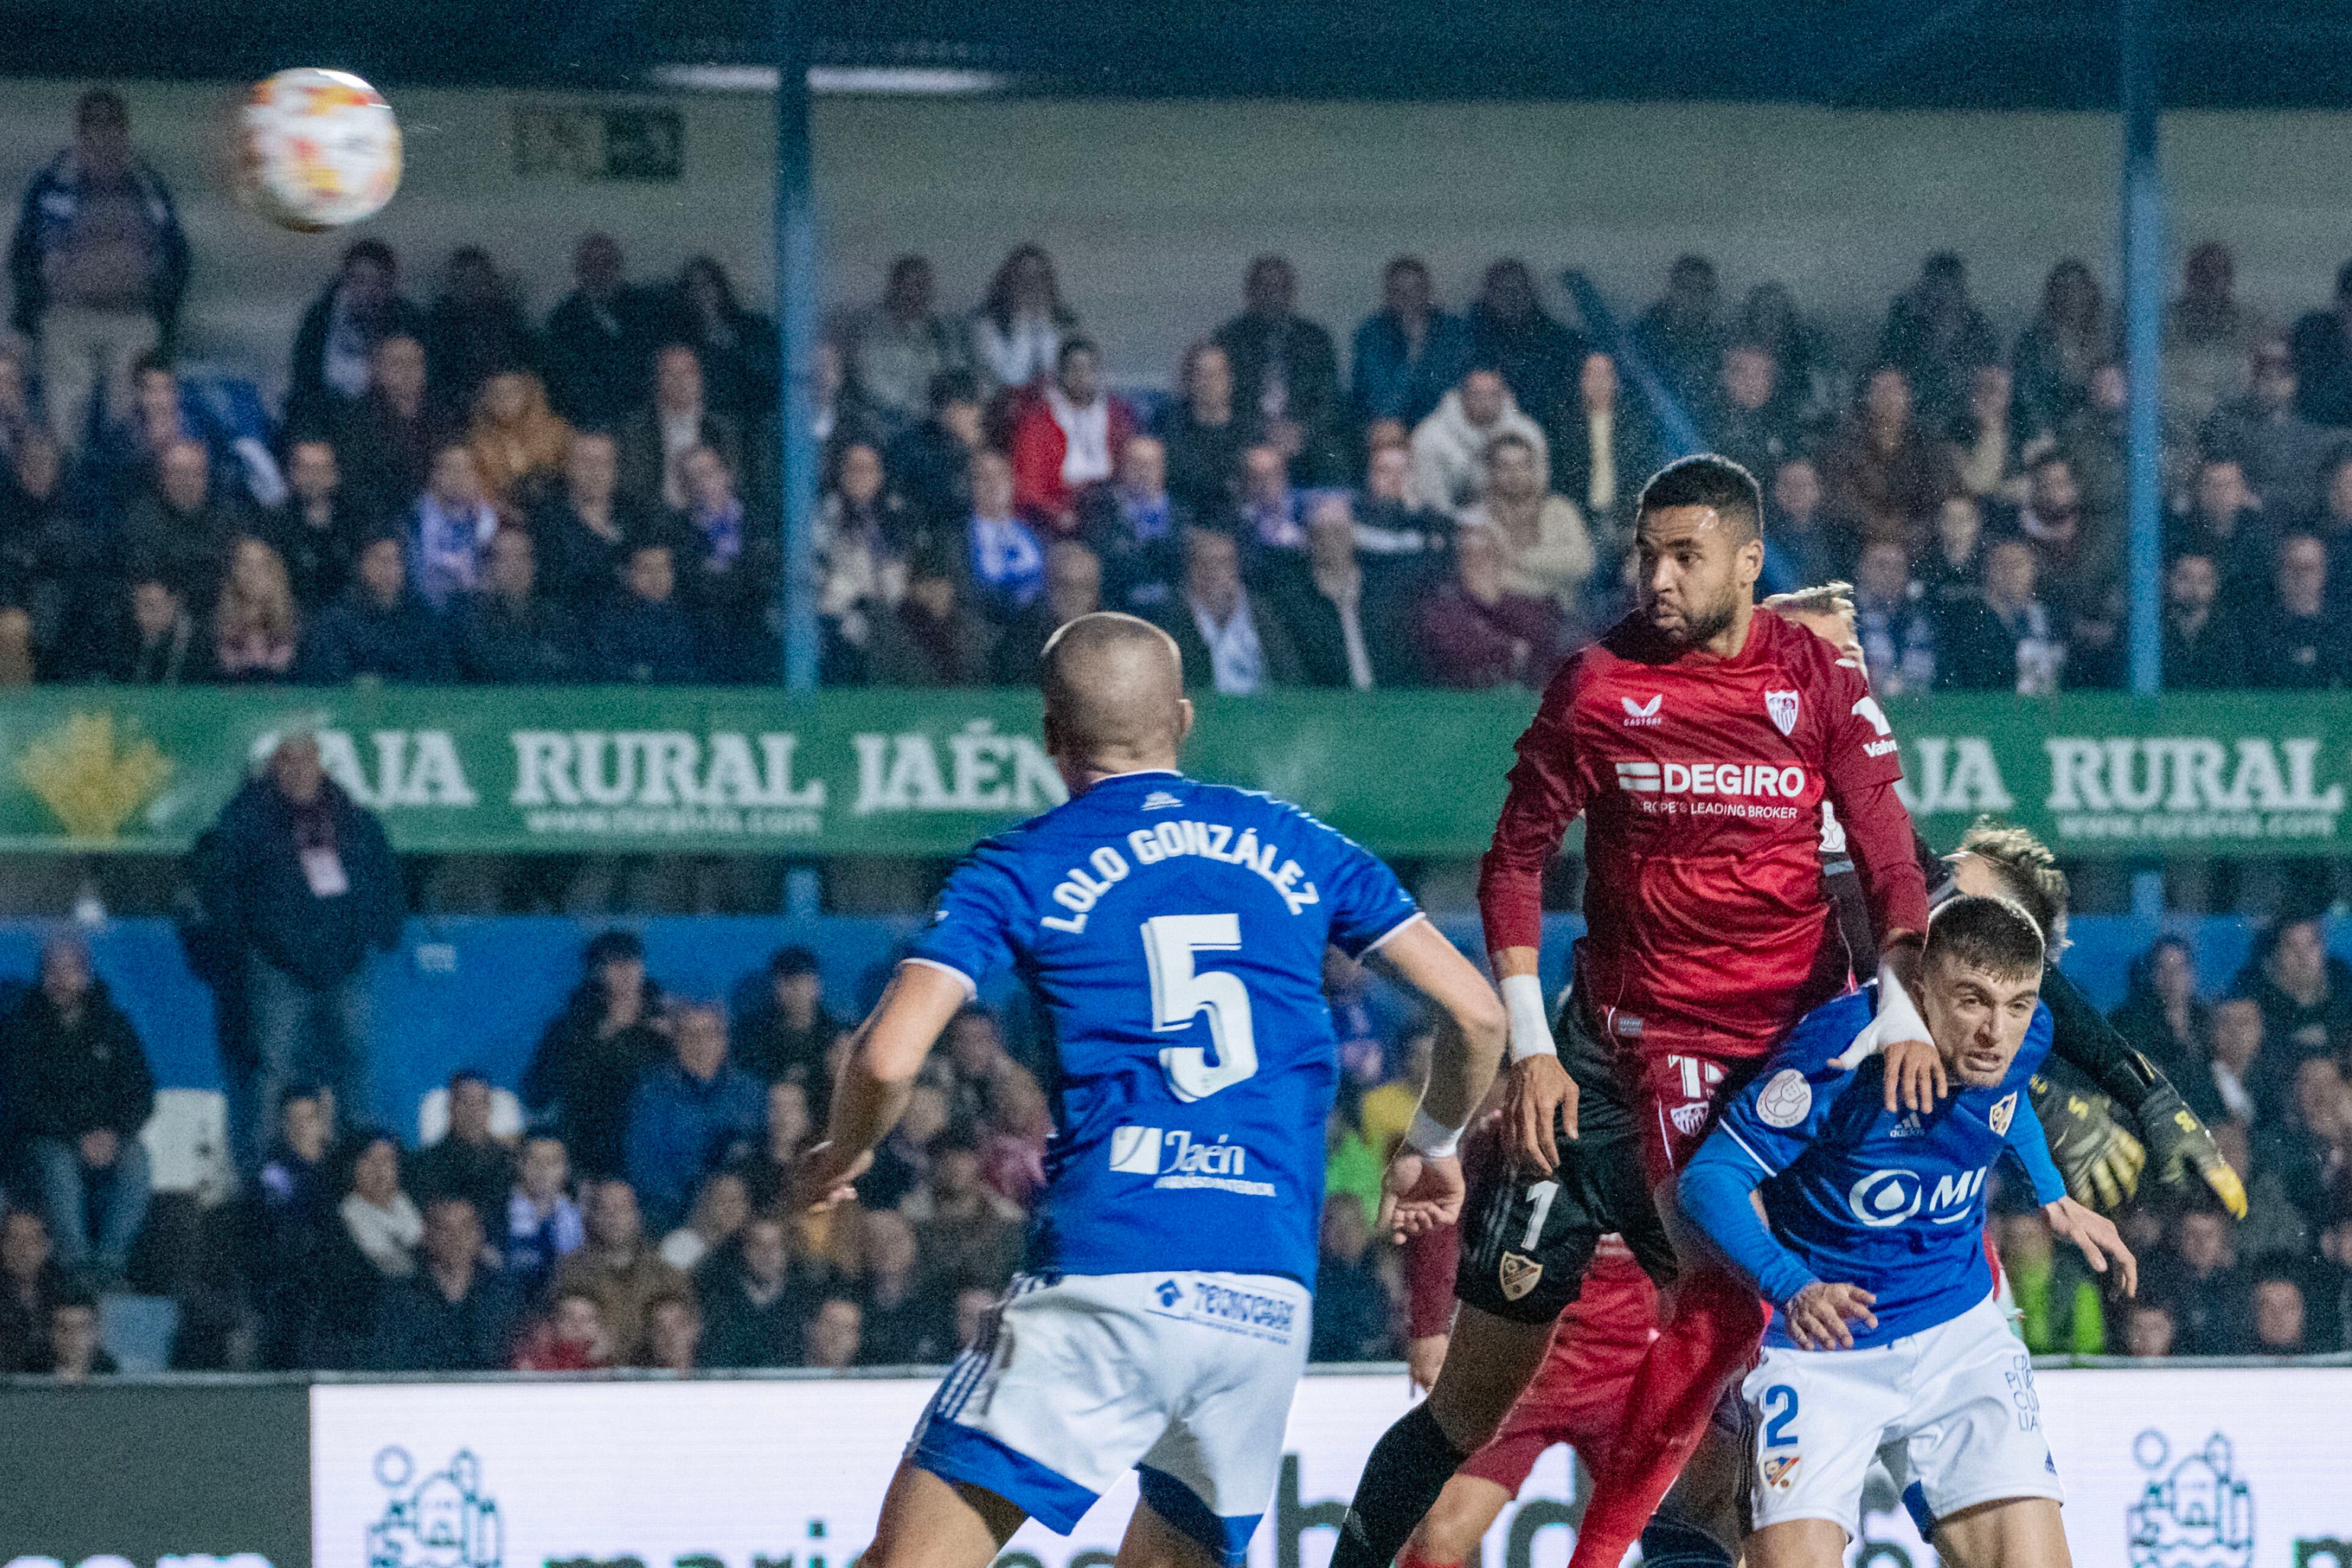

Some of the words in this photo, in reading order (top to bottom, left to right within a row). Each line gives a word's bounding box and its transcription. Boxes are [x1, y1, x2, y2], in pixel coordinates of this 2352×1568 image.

[511, 730, 826, 806] RURAL
[1664, 763, 1805, 798] DEGIRO
[2045, 736, 2343, 811] RURAL
[1691, 802, 1746, 817] LEADING
[1748, 805, 1797, 819] BROKER
[1040, 847, 1130, 934] LOLO
[1127, 820, 1320, 915] GONZÁLEZ
[1140, 913, 1259, 1103] 5
[1161, 1130, 1245, 1175] Jaén
[1520, 1180, 1559, 1251] 1
[1763, 1384, 1799, 1448] 2
